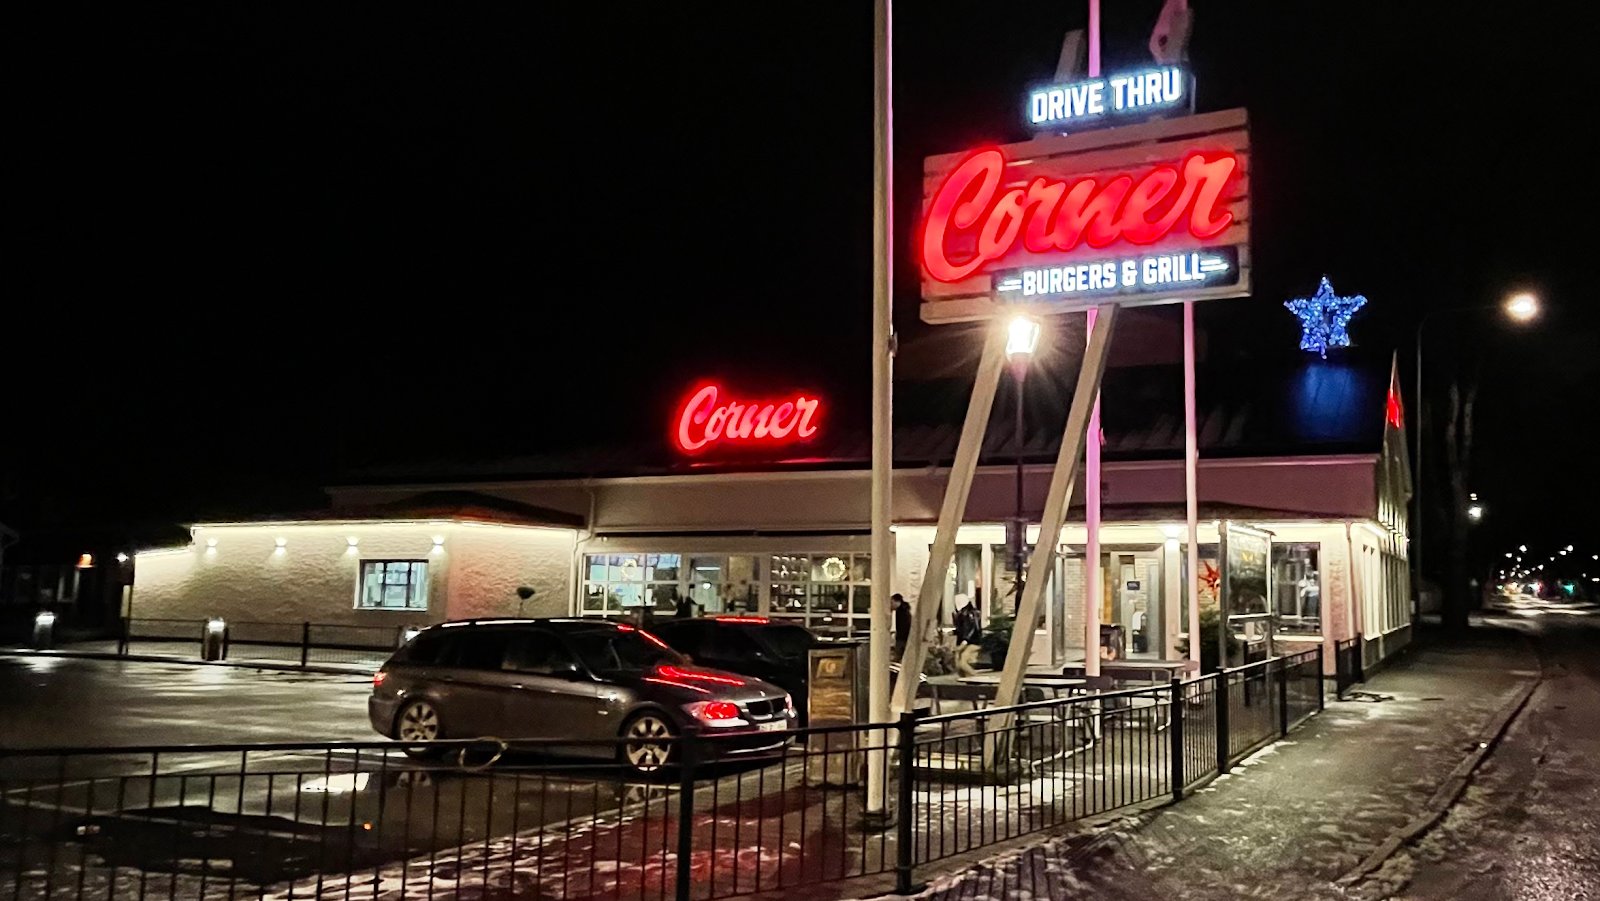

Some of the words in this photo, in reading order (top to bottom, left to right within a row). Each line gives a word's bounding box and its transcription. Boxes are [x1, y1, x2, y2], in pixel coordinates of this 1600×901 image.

[1031, 82, 1104, 124] DRIVE
[1110, 68, 1180, 110] THRU
[923, 150, 1236, 282] Corner
[1023, 265, 1117, 296] BURGERS
[1122, 263, 1138, 286] &
[1142, 254, 1205, 284] GRILL
[679, 386, 818, 450] Corner
